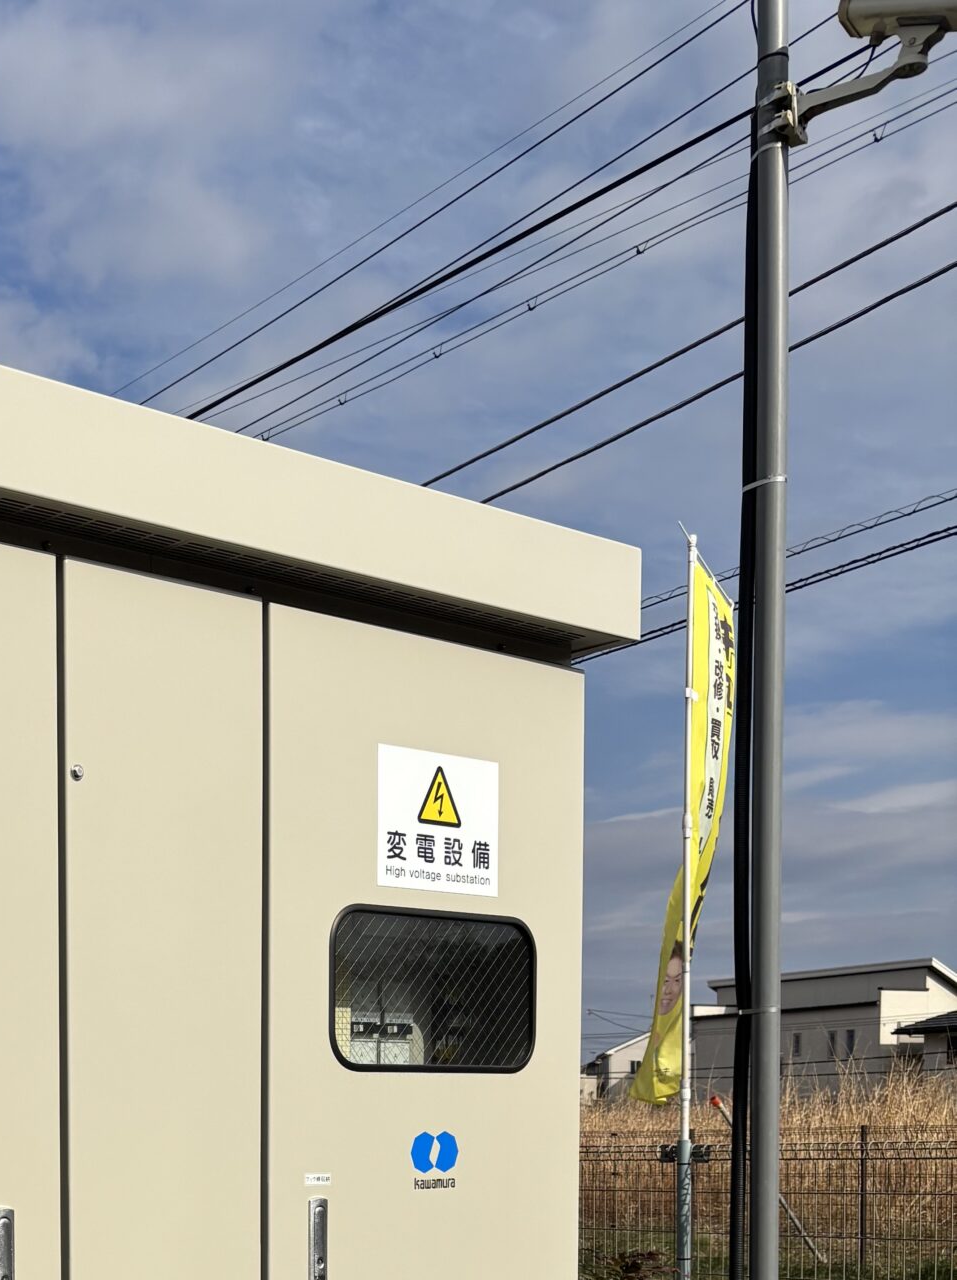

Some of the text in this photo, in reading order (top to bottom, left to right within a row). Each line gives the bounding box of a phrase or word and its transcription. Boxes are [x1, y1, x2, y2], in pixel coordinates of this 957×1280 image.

[387, 830, 490, 870] 変電設備
[385, 865, 491, 886] High voltage substation
[413, 1177, 456, 1190] kawamura
